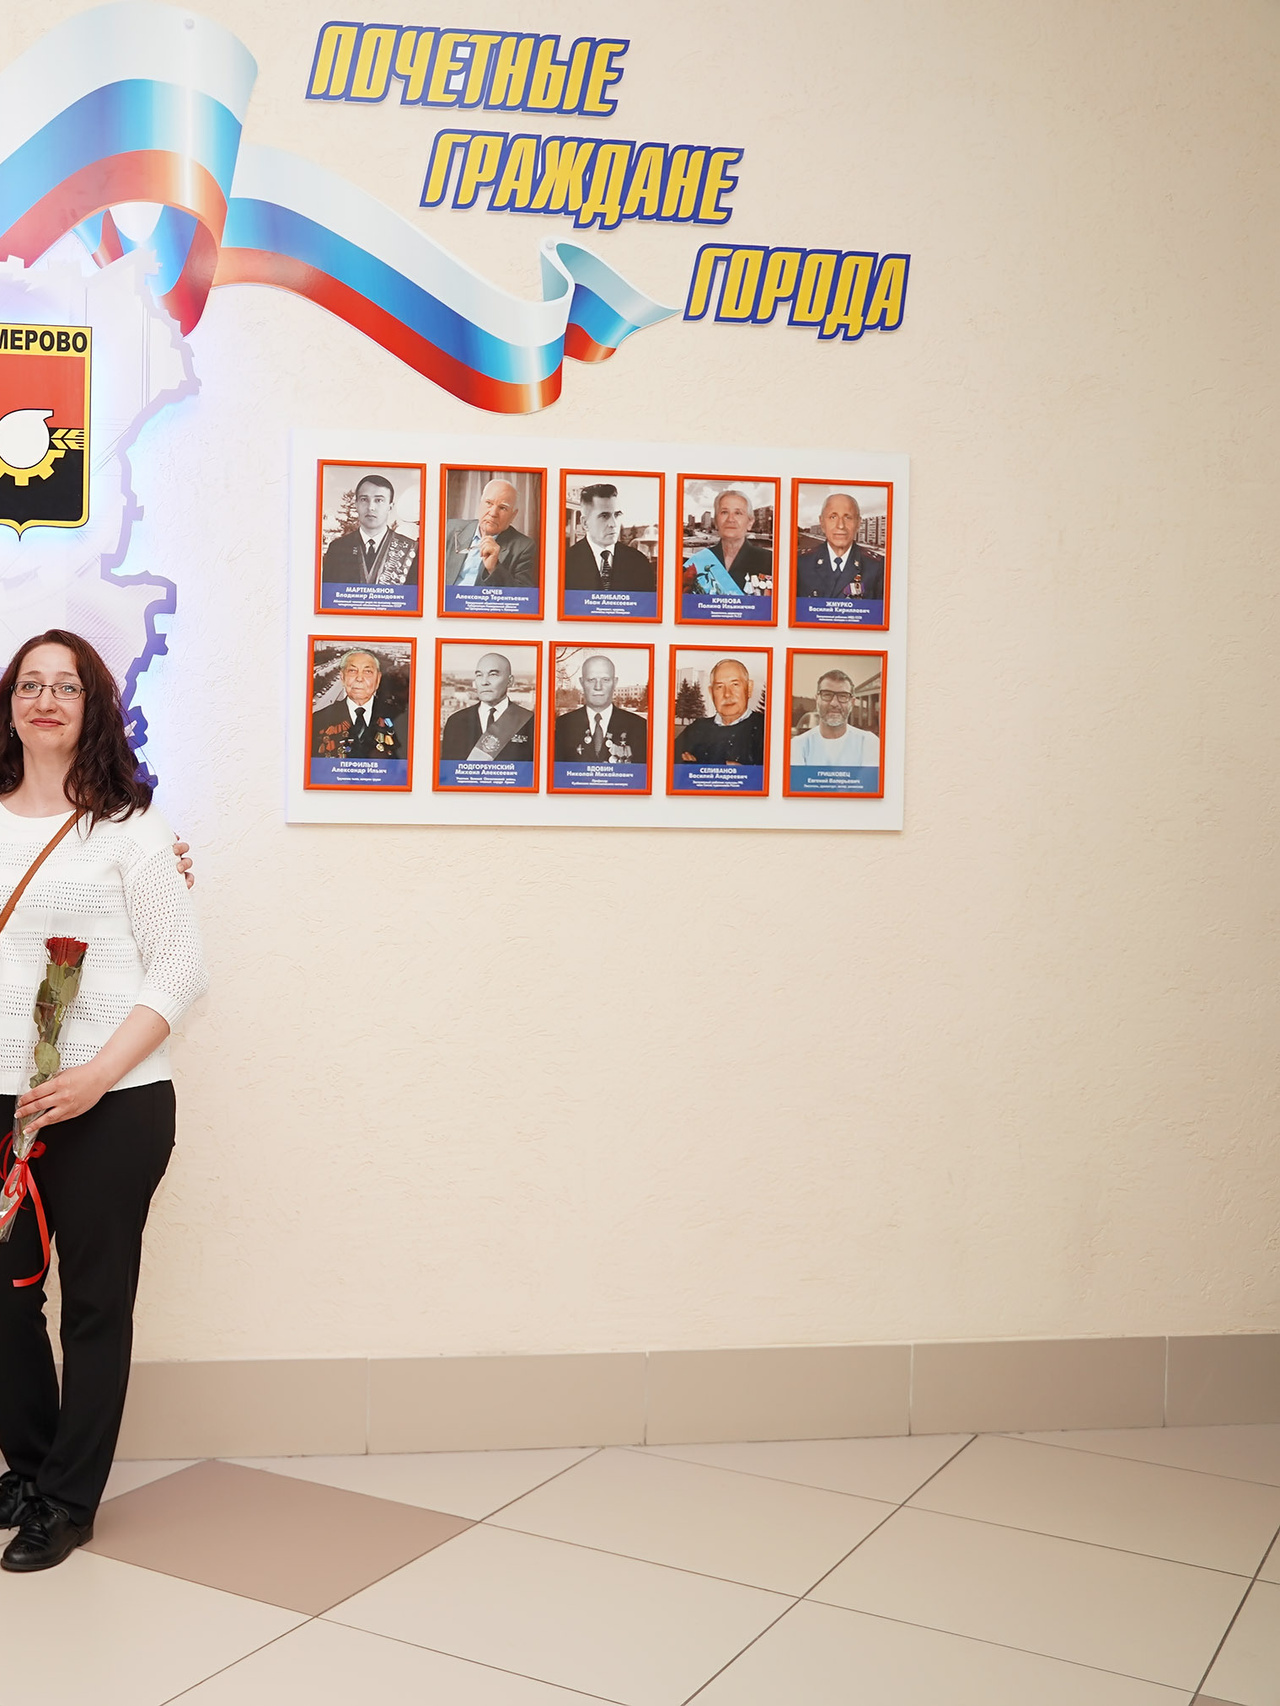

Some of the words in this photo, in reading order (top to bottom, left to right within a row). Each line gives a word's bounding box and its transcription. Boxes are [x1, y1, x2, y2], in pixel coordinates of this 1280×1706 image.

[307, 21, 630, 116] ПОЧЕТНЫЕ
[420, 129, 743, 229] ГРАЖДАНЕ
[684, 243, 910, 341] ГОРОДА
[346, 586, 394, 594] МАРТЕМЬЯНОВ
